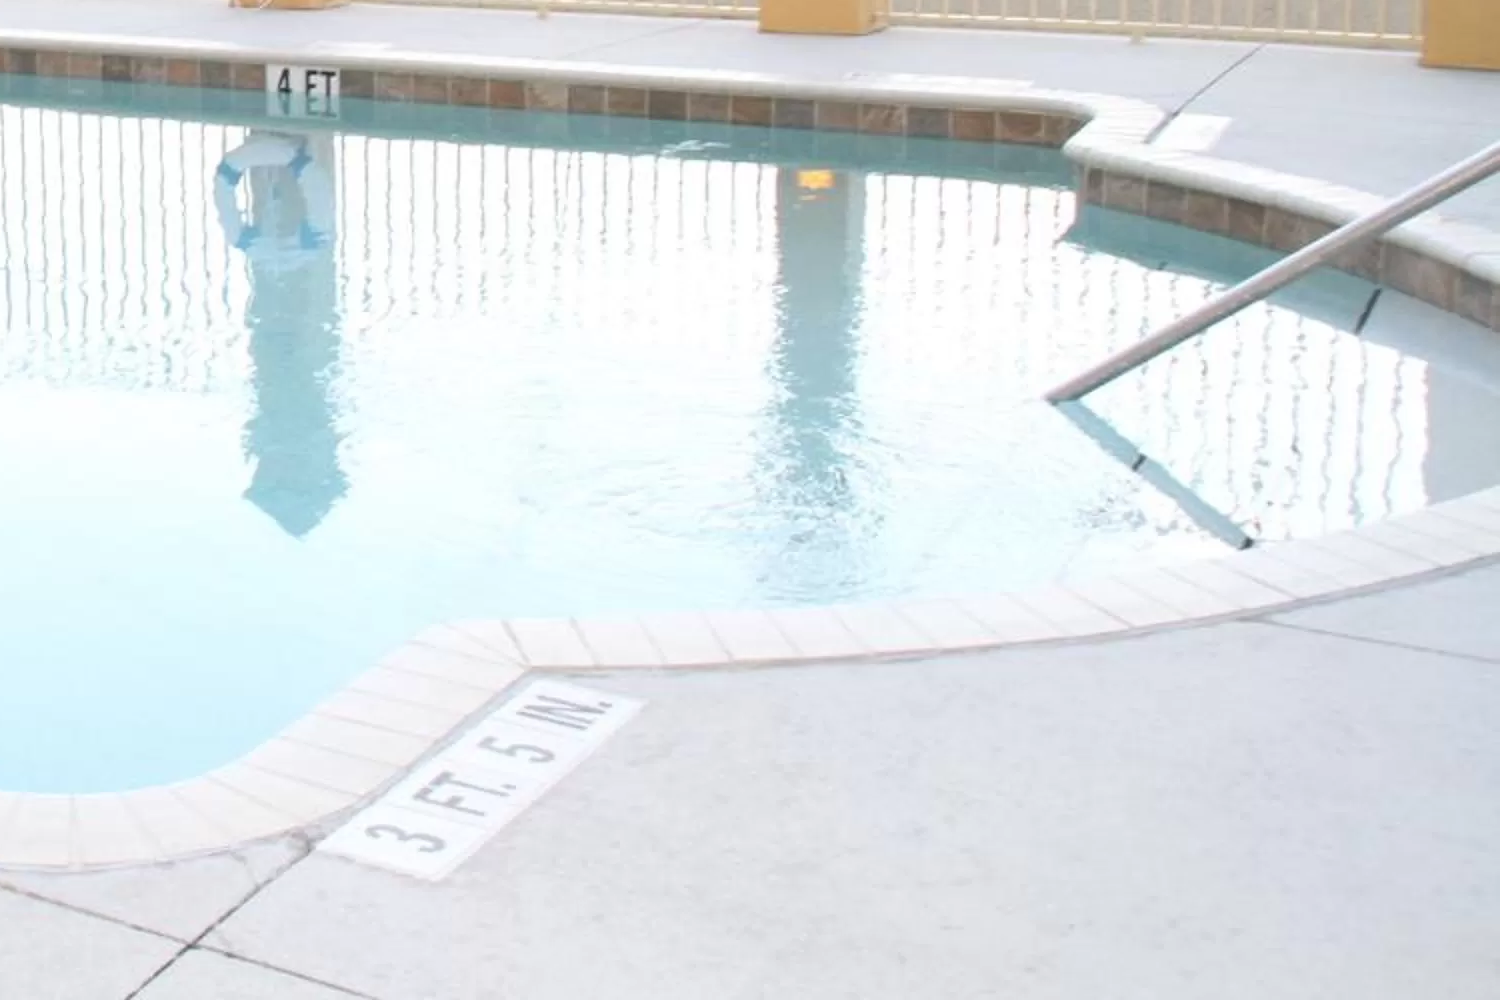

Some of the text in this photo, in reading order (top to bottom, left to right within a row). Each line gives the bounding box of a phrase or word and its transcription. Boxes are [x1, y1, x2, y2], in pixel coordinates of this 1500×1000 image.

[277, 67, 336, 98] 4 FT
[365, 694, 613, 854] 3 FT. 5 IN.
